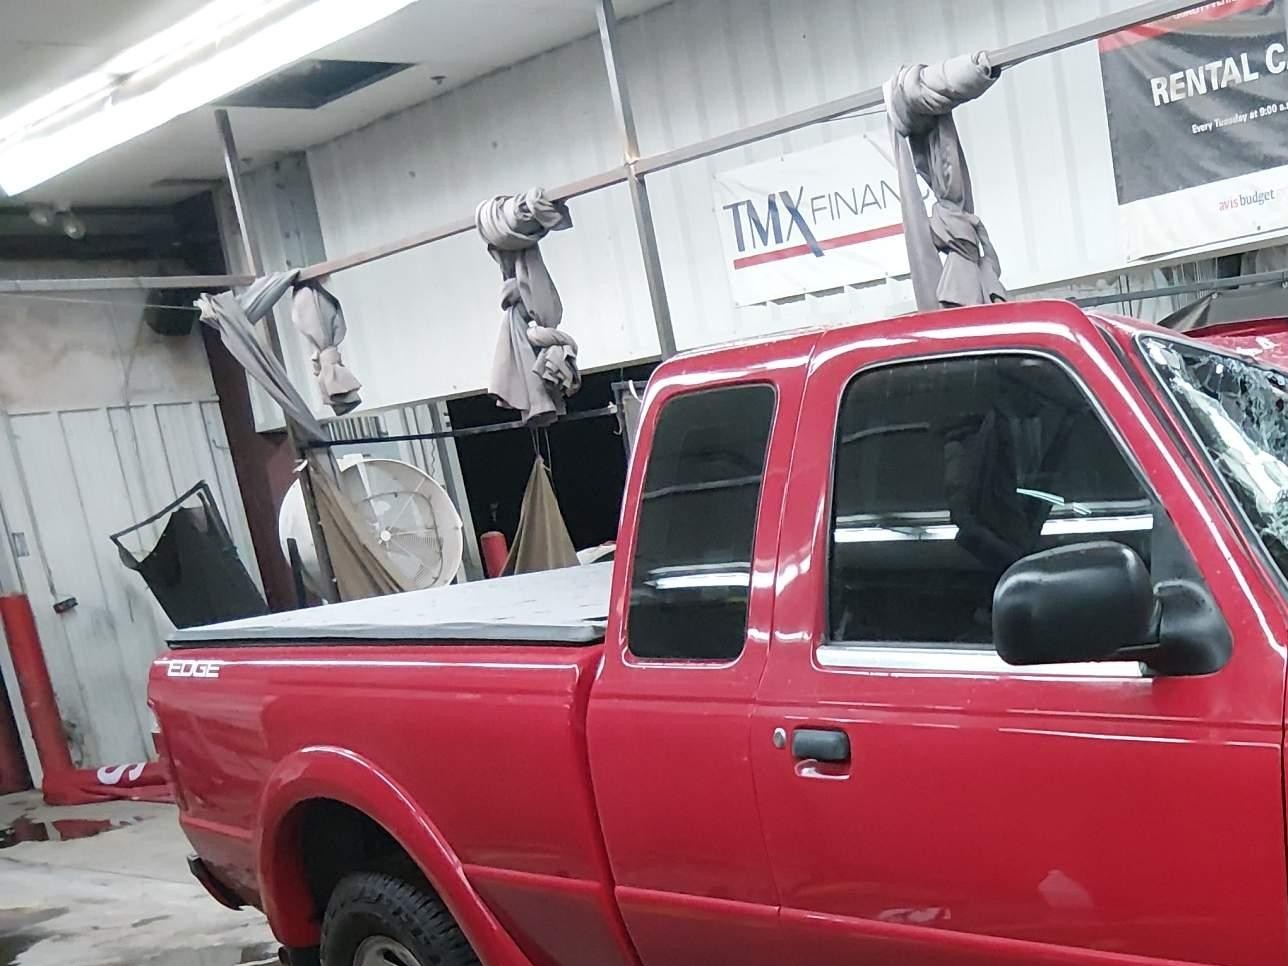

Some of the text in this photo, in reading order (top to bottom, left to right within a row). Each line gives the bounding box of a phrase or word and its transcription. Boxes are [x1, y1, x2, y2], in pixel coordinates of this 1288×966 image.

[1151, 52, 1259, 107] RENTAL
[1191, 122, 1213, 134] Every
[1249, 109, 1258, 120] at
[1259, 103, 1278, 117] 9:00
[723, 180, 929, 258] TMX FINAN
[167, 659, 221, 678] EDGE
